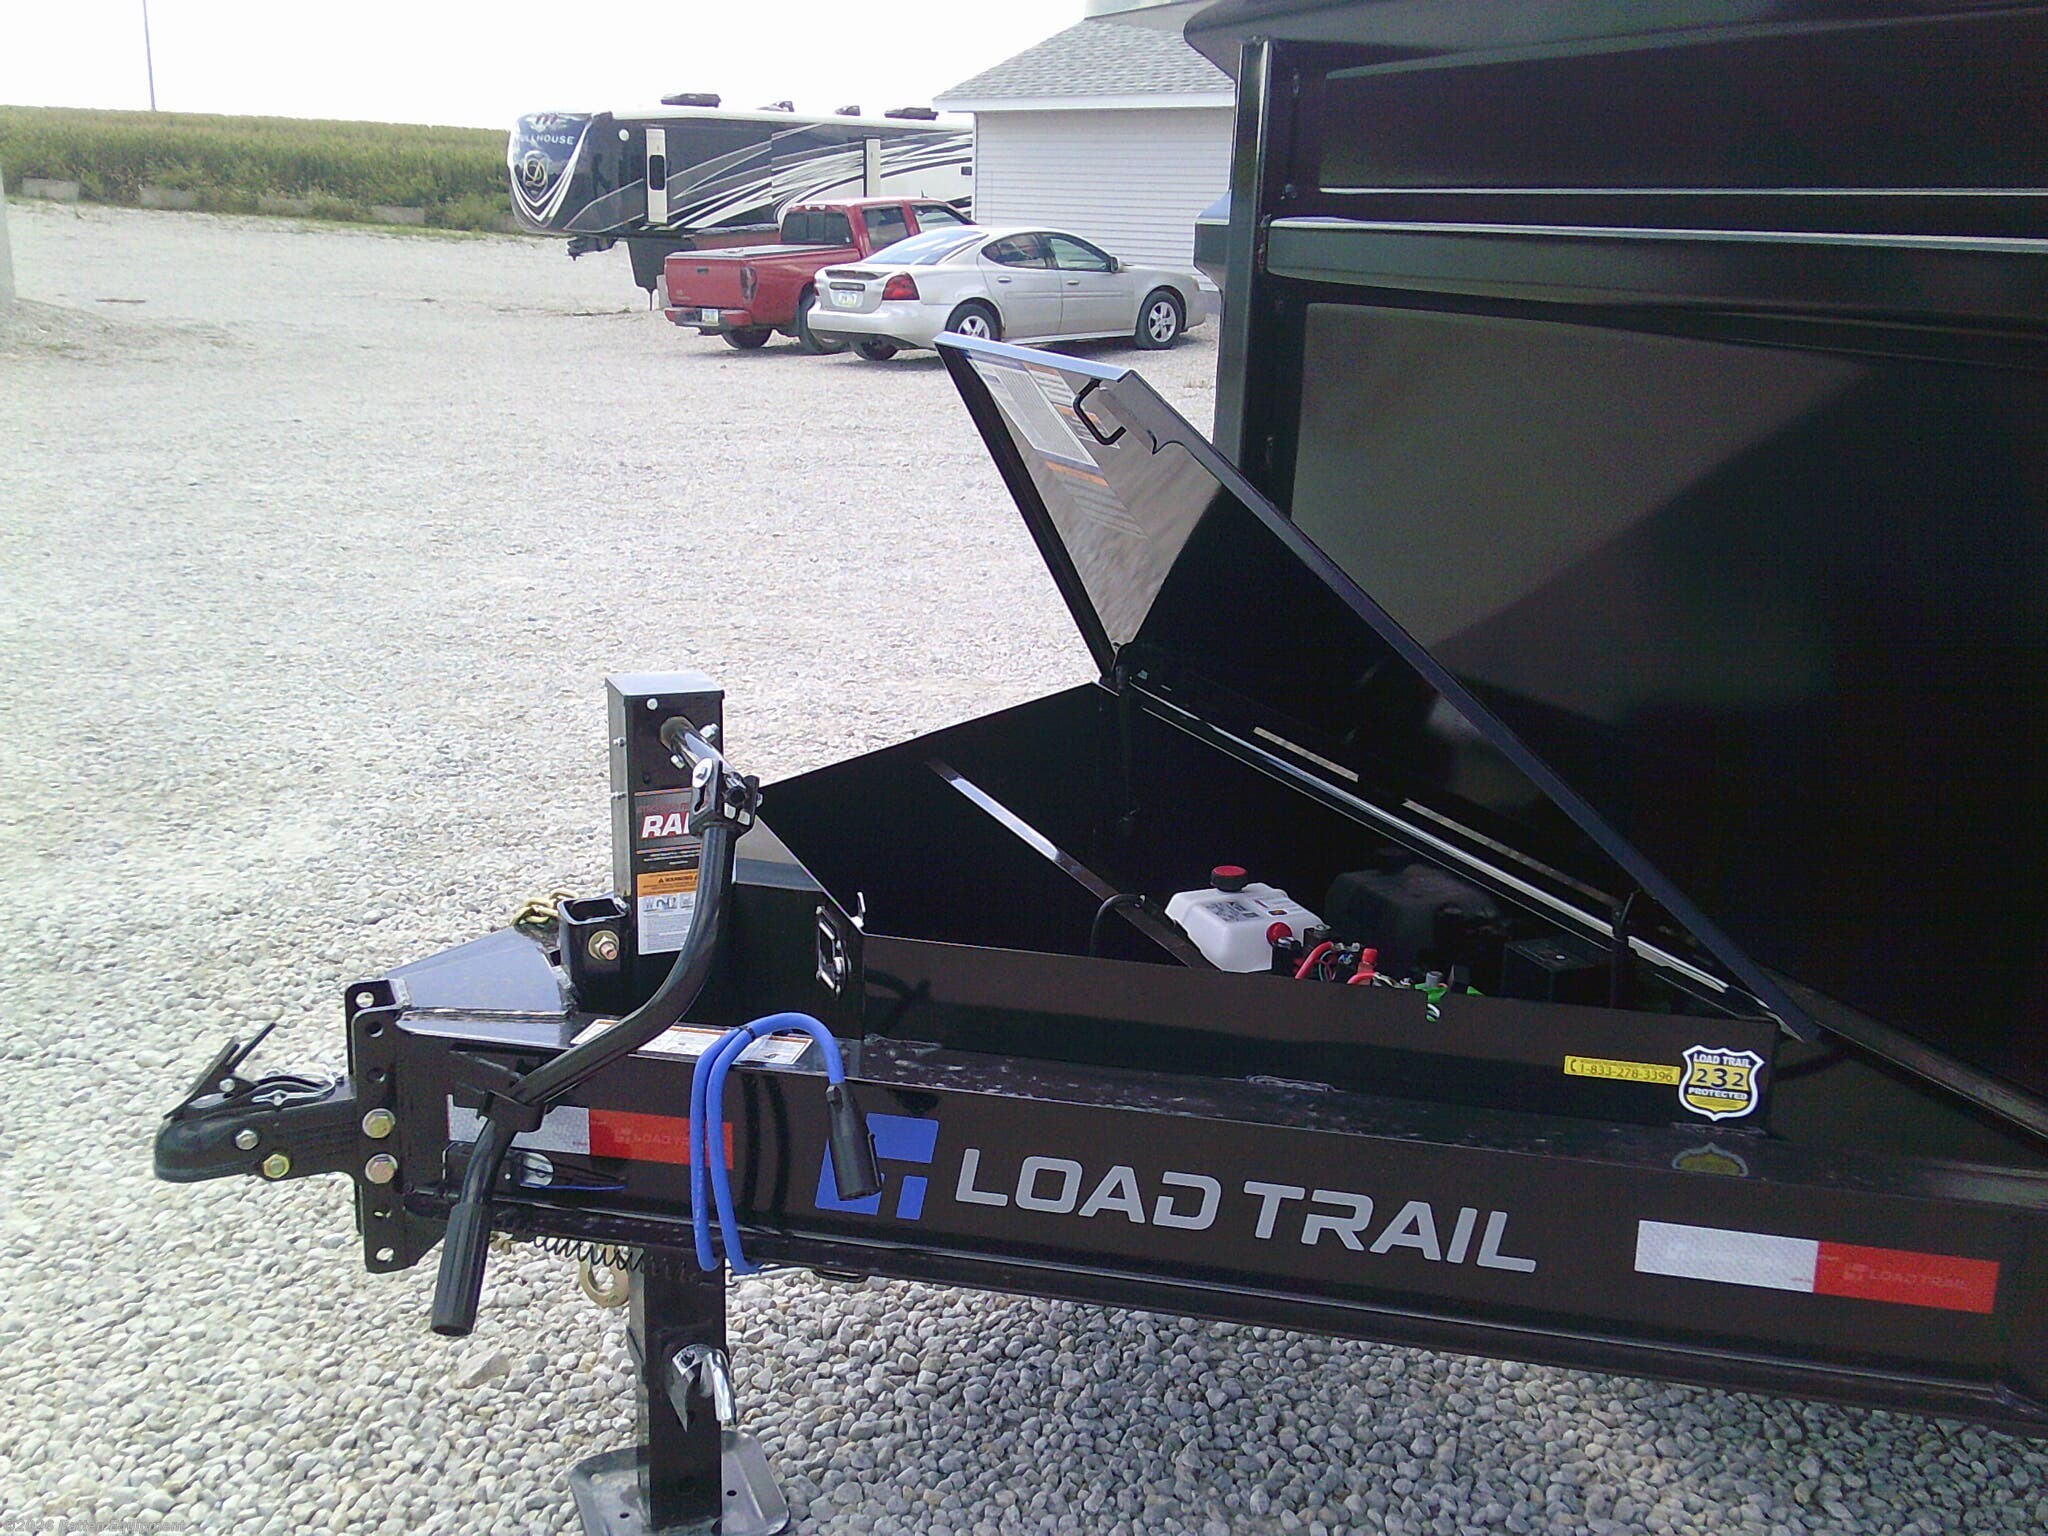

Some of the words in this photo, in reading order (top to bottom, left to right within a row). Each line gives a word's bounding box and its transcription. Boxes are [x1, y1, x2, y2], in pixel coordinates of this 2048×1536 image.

[1693, 1053, 1721, 1065] LOAD
[1722, 1055, 1752, 1068] TRAIL
[1580, 1063, 1673, 1082] 1-833-278-3396
[1696, 1068, 1744, 1089] 232
[1688, 1087, 1748, 1100] PROTECTED
[956, 1148, 1222, 1231] LOAD
[1243, 1180, 1537, 1274] TRAIL
